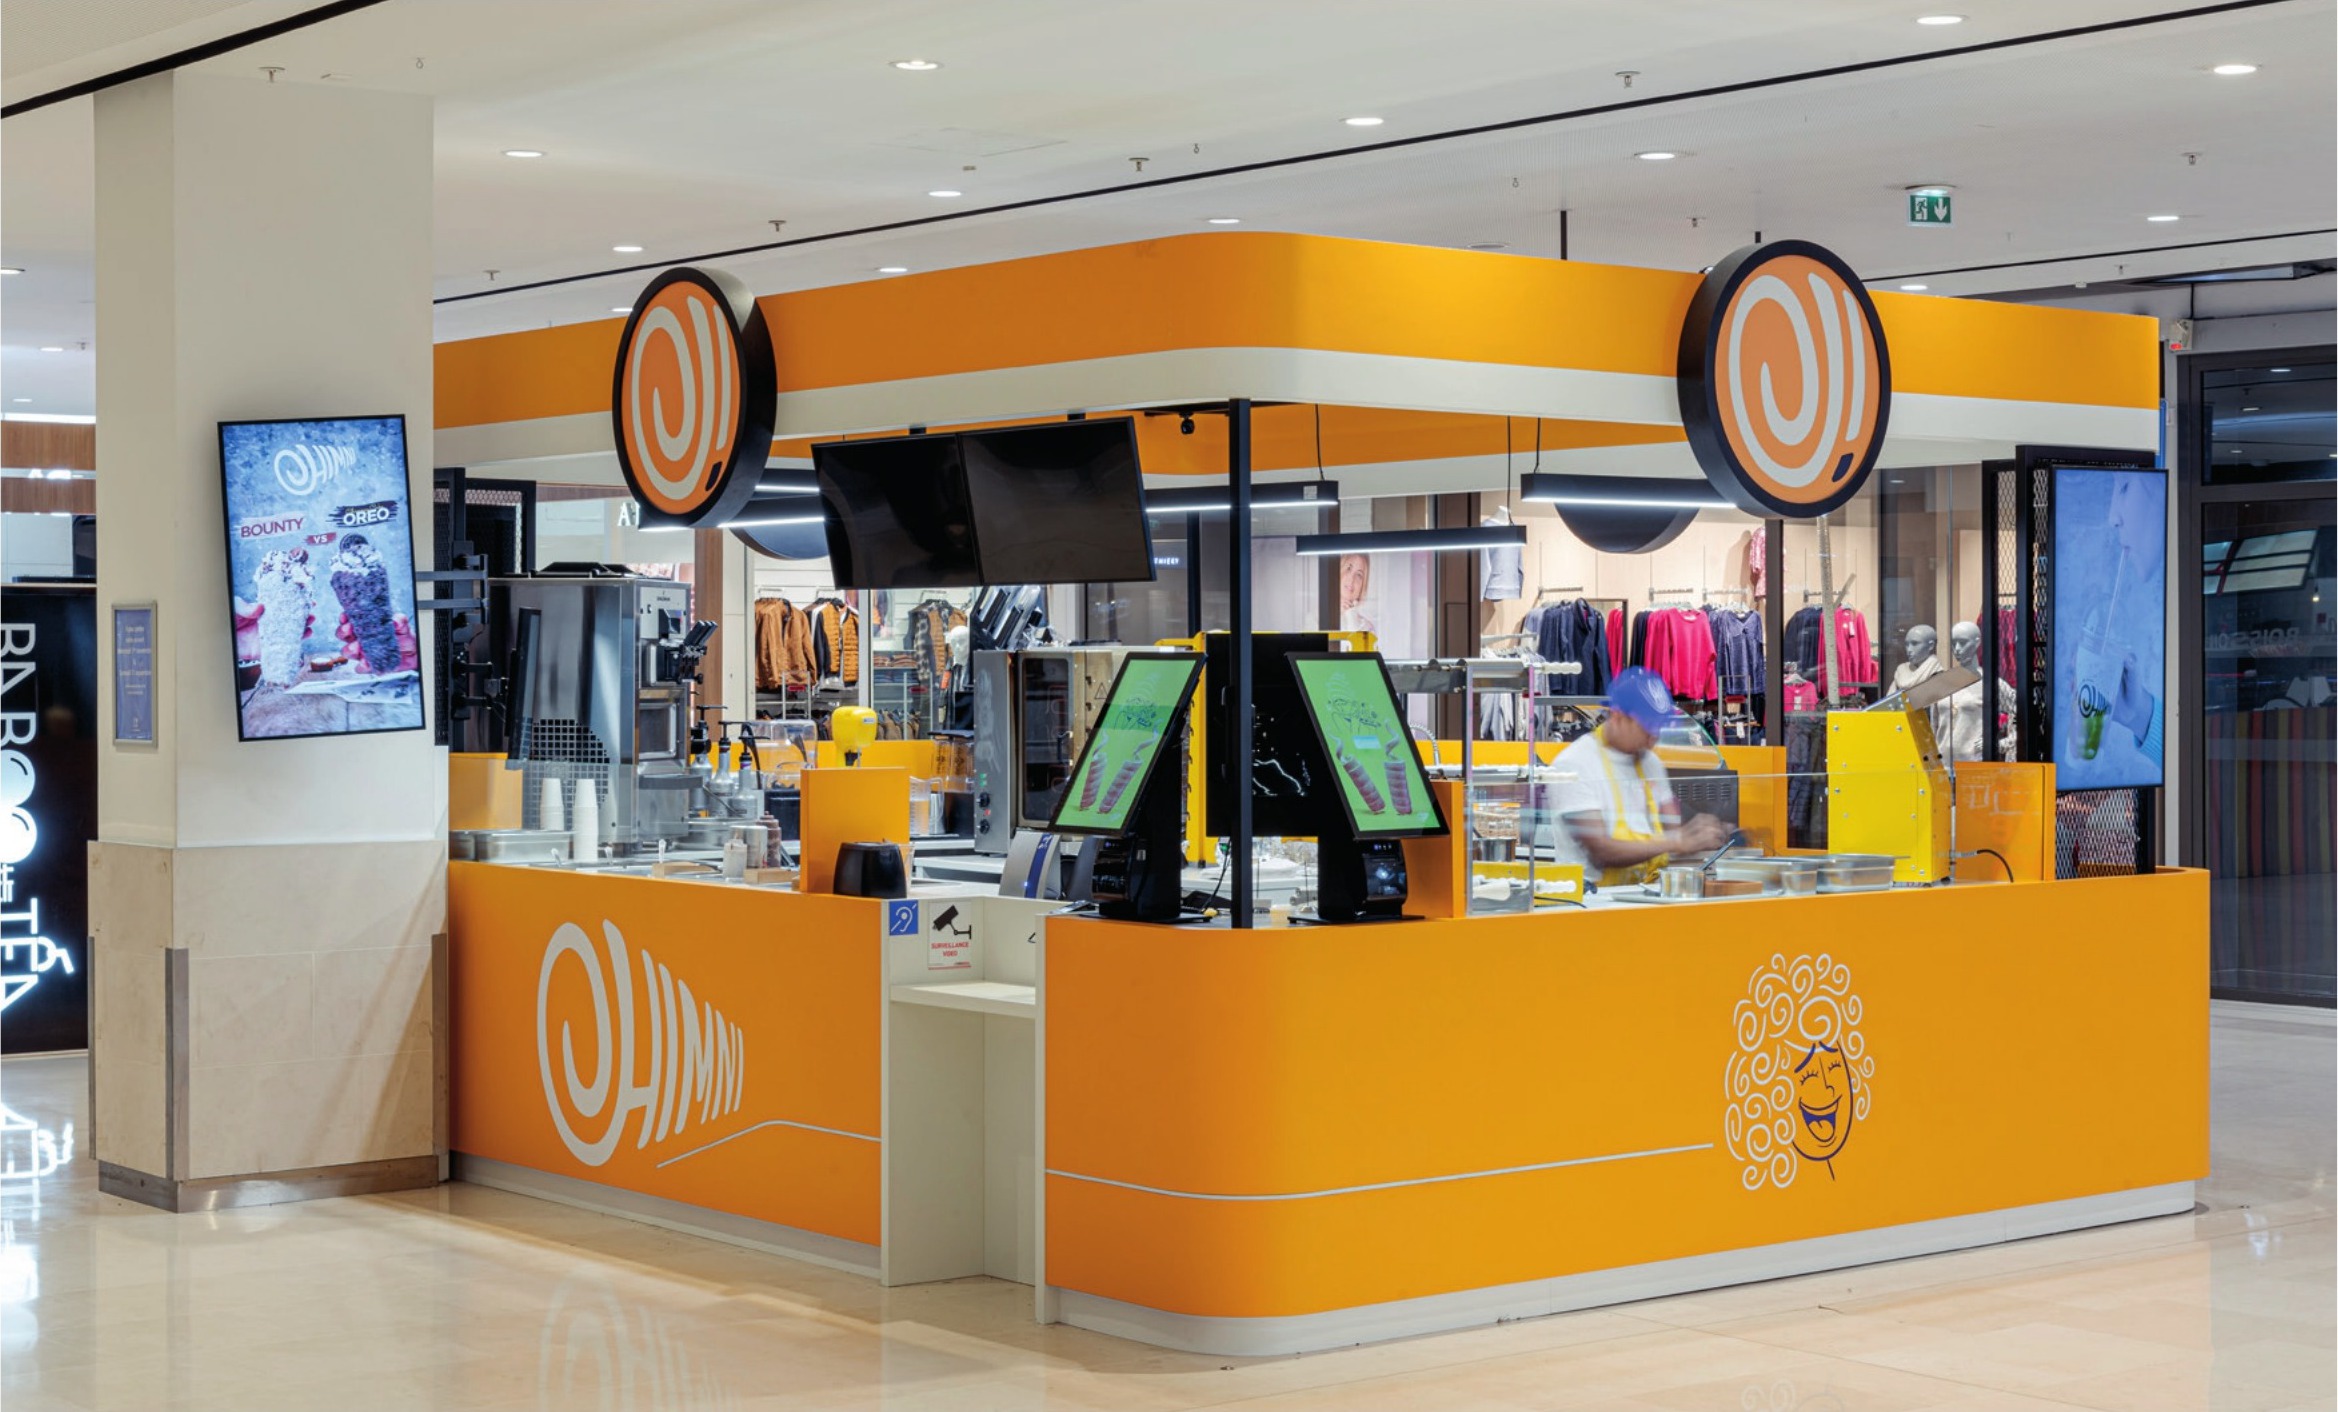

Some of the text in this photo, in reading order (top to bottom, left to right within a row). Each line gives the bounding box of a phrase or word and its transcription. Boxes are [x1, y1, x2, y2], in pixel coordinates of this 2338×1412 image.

[343, 507, 389, 526] OREO
[241, 518, 304, 538] BOUNTY
[314, 534, 328, 544] VS
[931, 941, 970, 950] SURVEILLANCE
